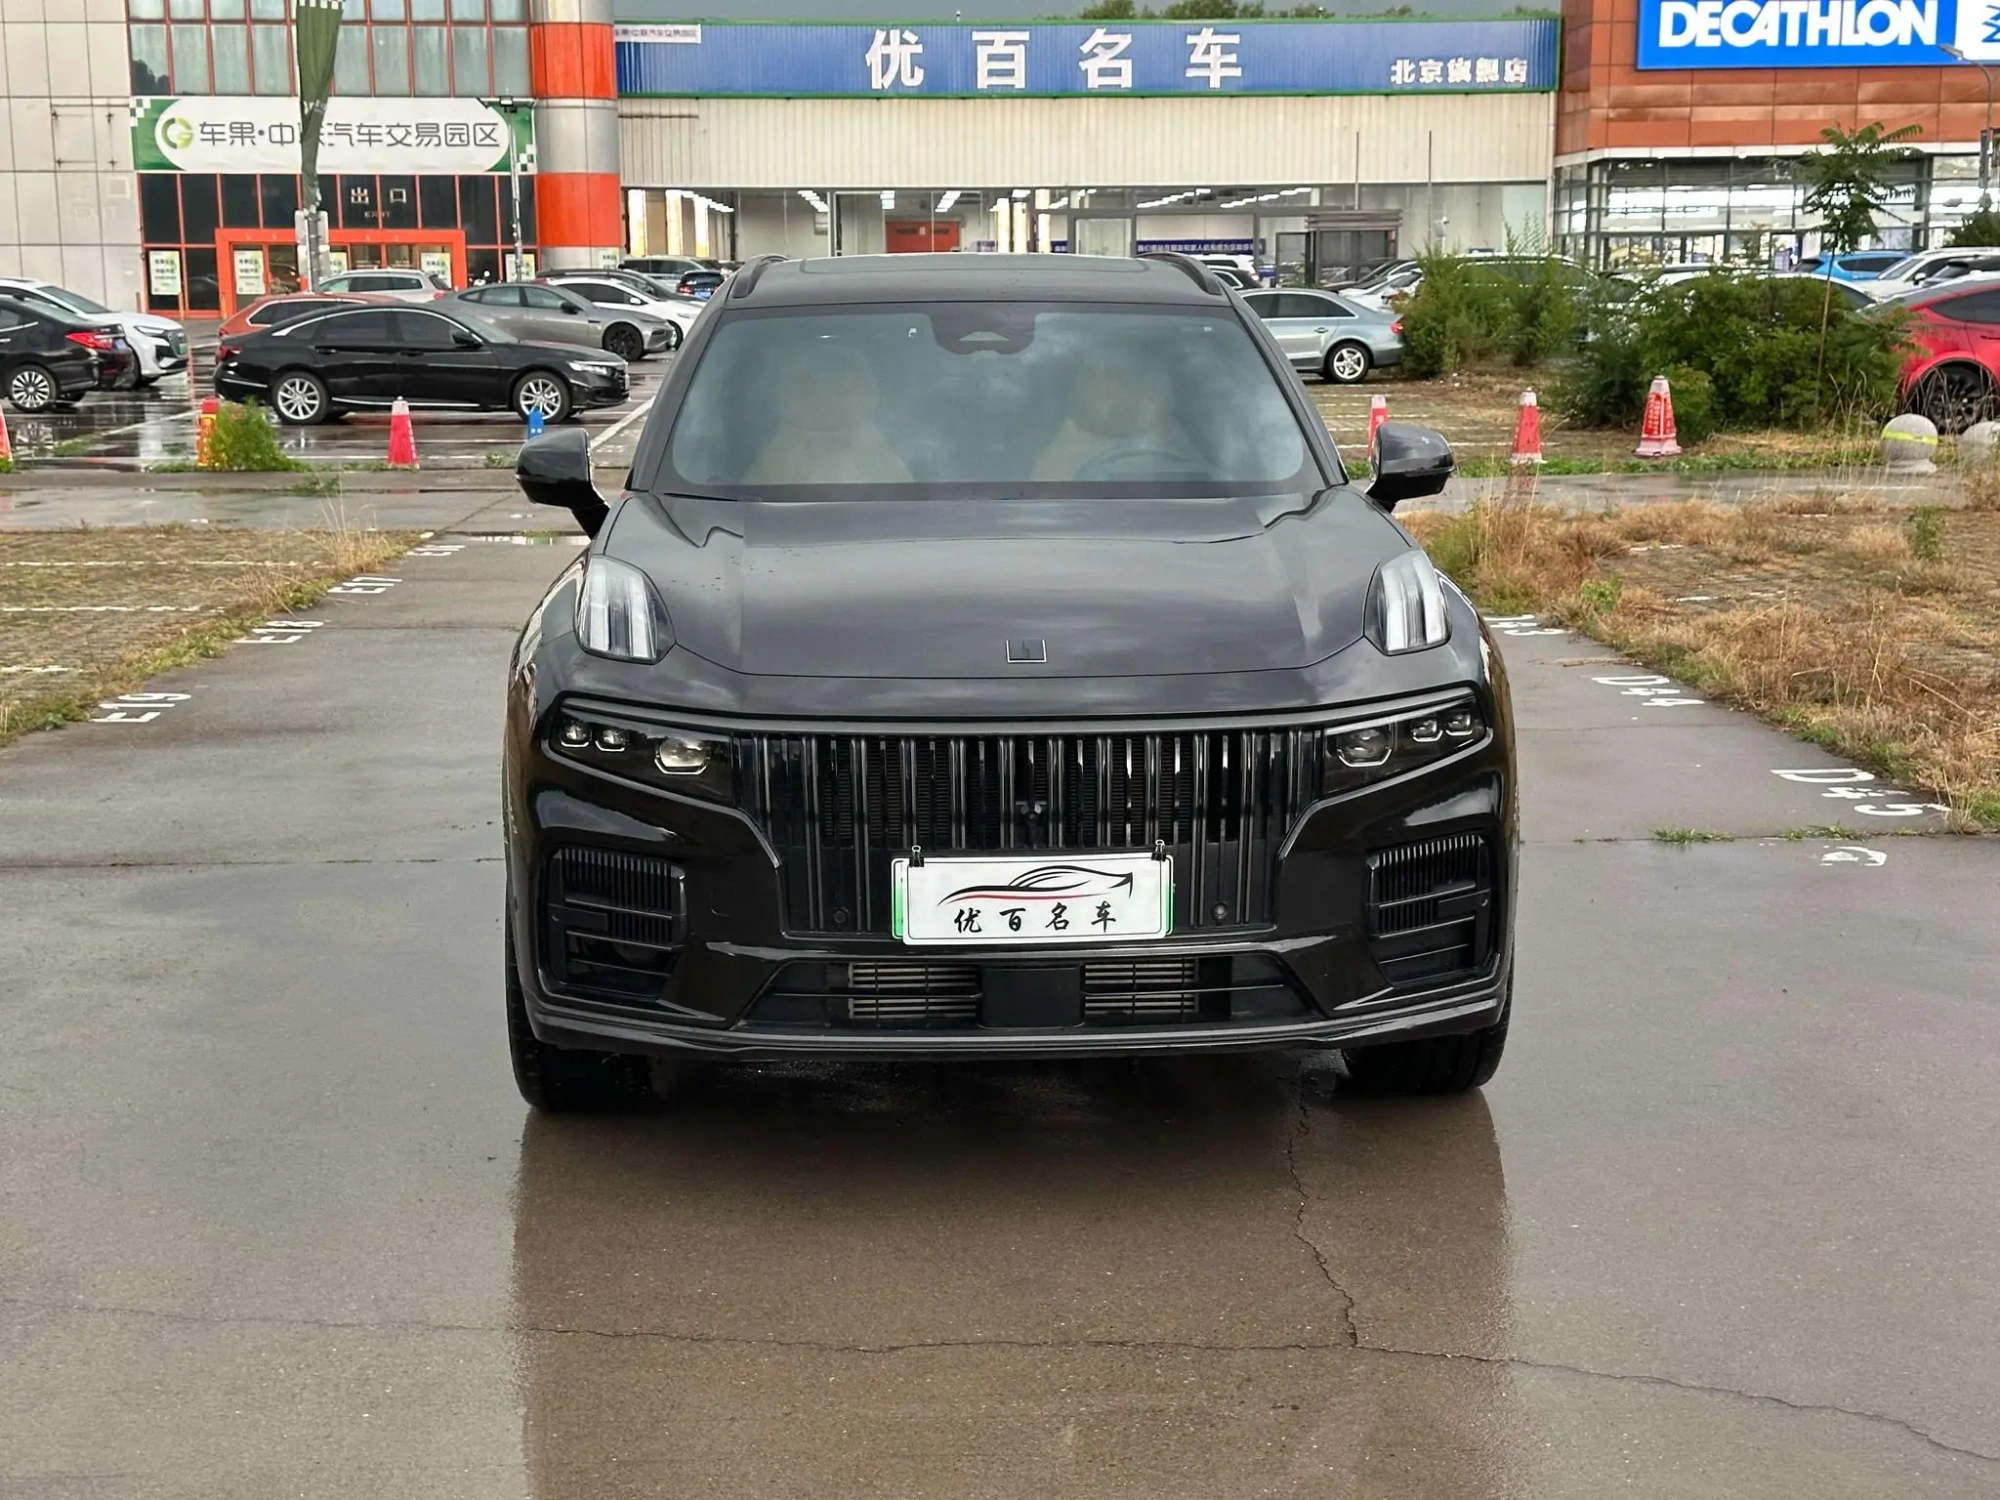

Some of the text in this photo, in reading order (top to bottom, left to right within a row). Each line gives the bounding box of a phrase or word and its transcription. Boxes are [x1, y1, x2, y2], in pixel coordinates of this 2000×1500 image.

[1659, 0, 1937, 47] DECATHLON
[864, 27, 1242, 90] 优百名车
[1390, 57, 1528, 85] 北京旗舰店
[350, 187, 407, 205] 出口
[232, 620, 324, 644] E18
[90, 692, 192, 723] E19
[953, 901, 1117, 934] 优百名车
